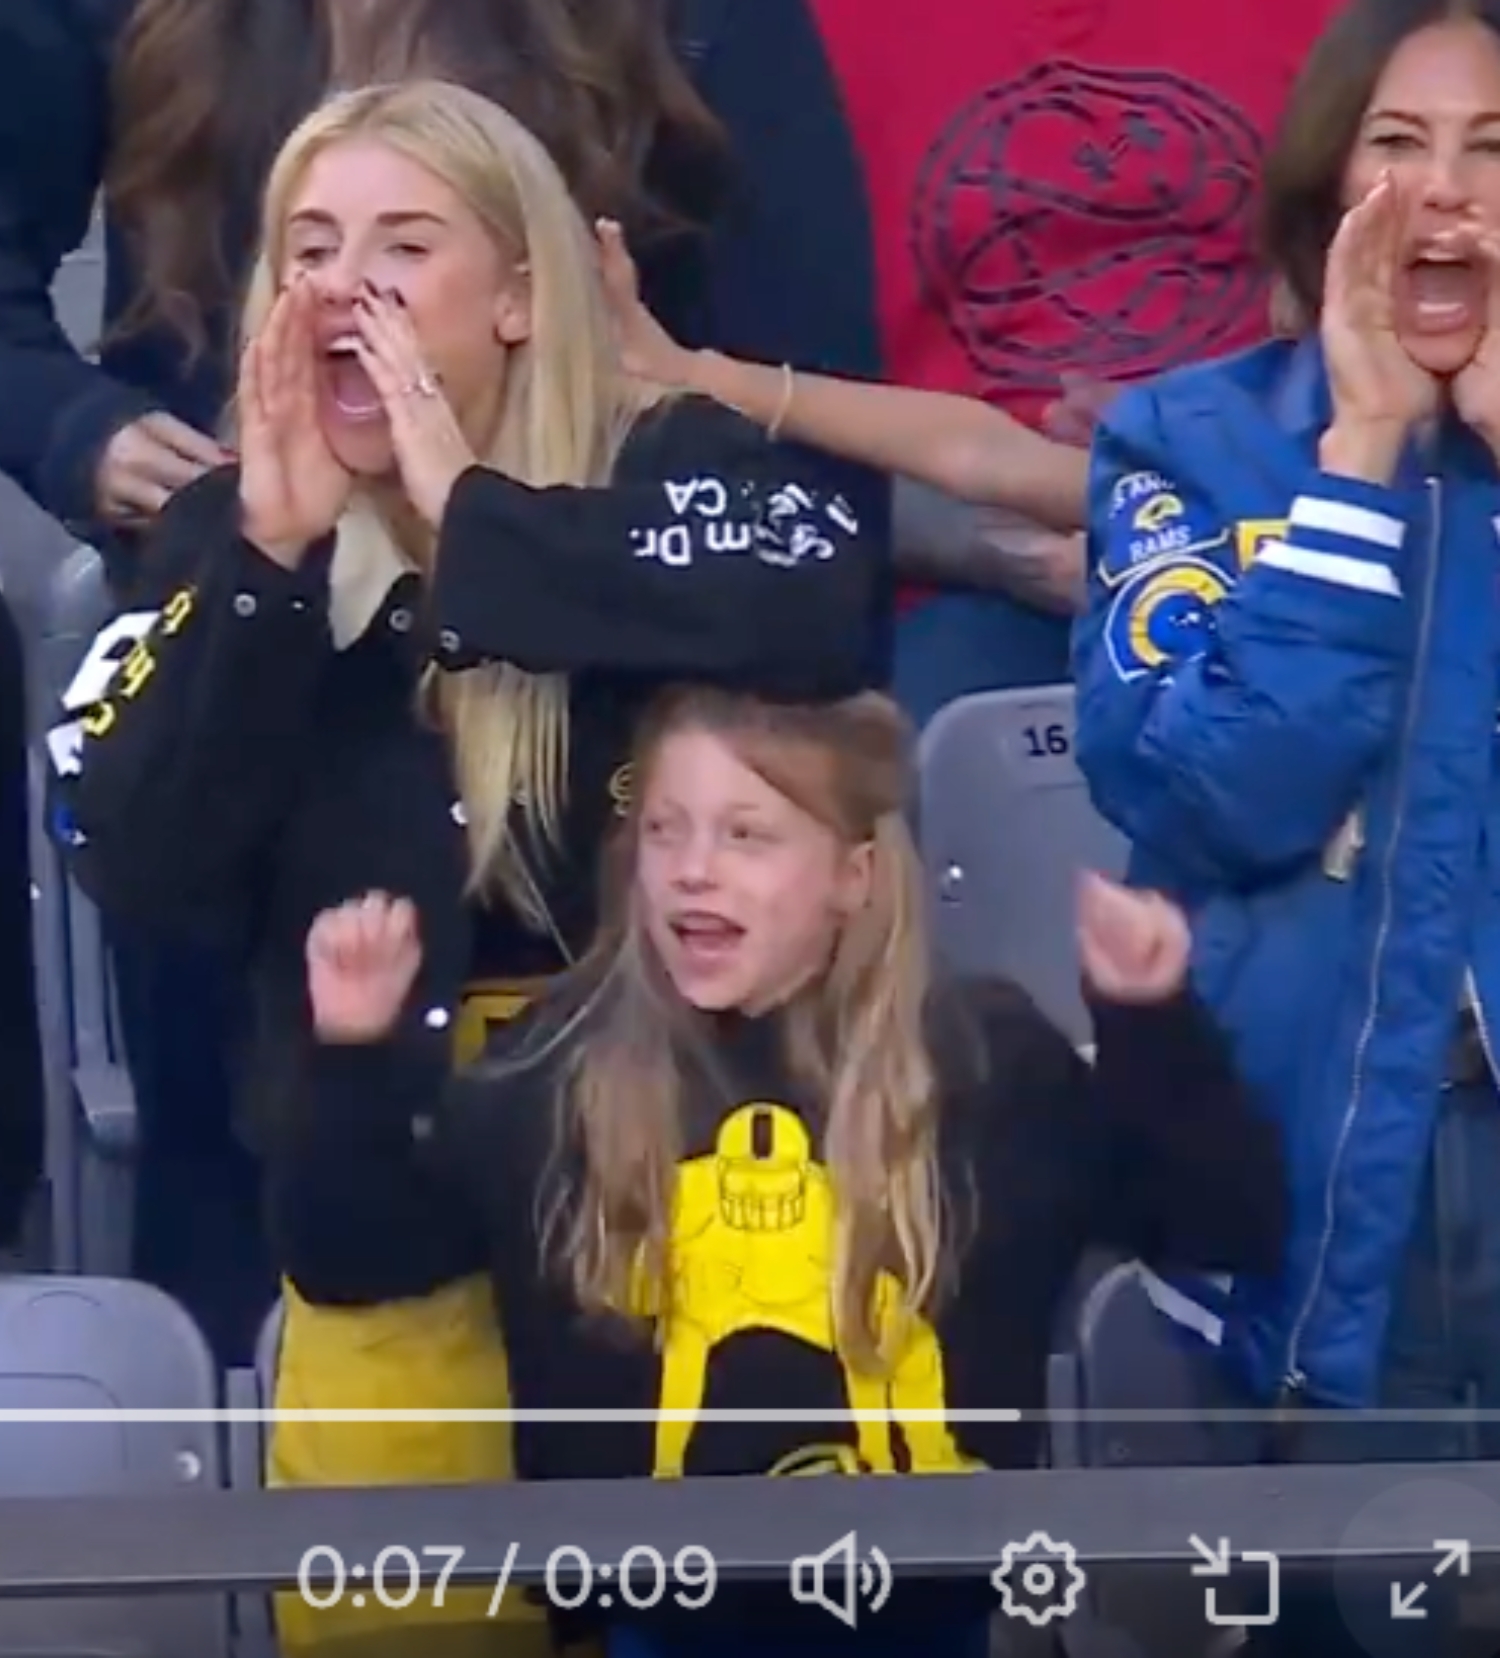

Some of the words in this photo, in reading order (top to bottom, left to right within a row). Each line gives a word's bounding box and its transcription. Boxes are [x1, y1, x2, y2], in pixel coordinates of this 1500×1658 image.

[663, 478, 727, 517] CA
[628, 524, 692, 567] Dr.
[1022, 723, 1068, 757] 16
